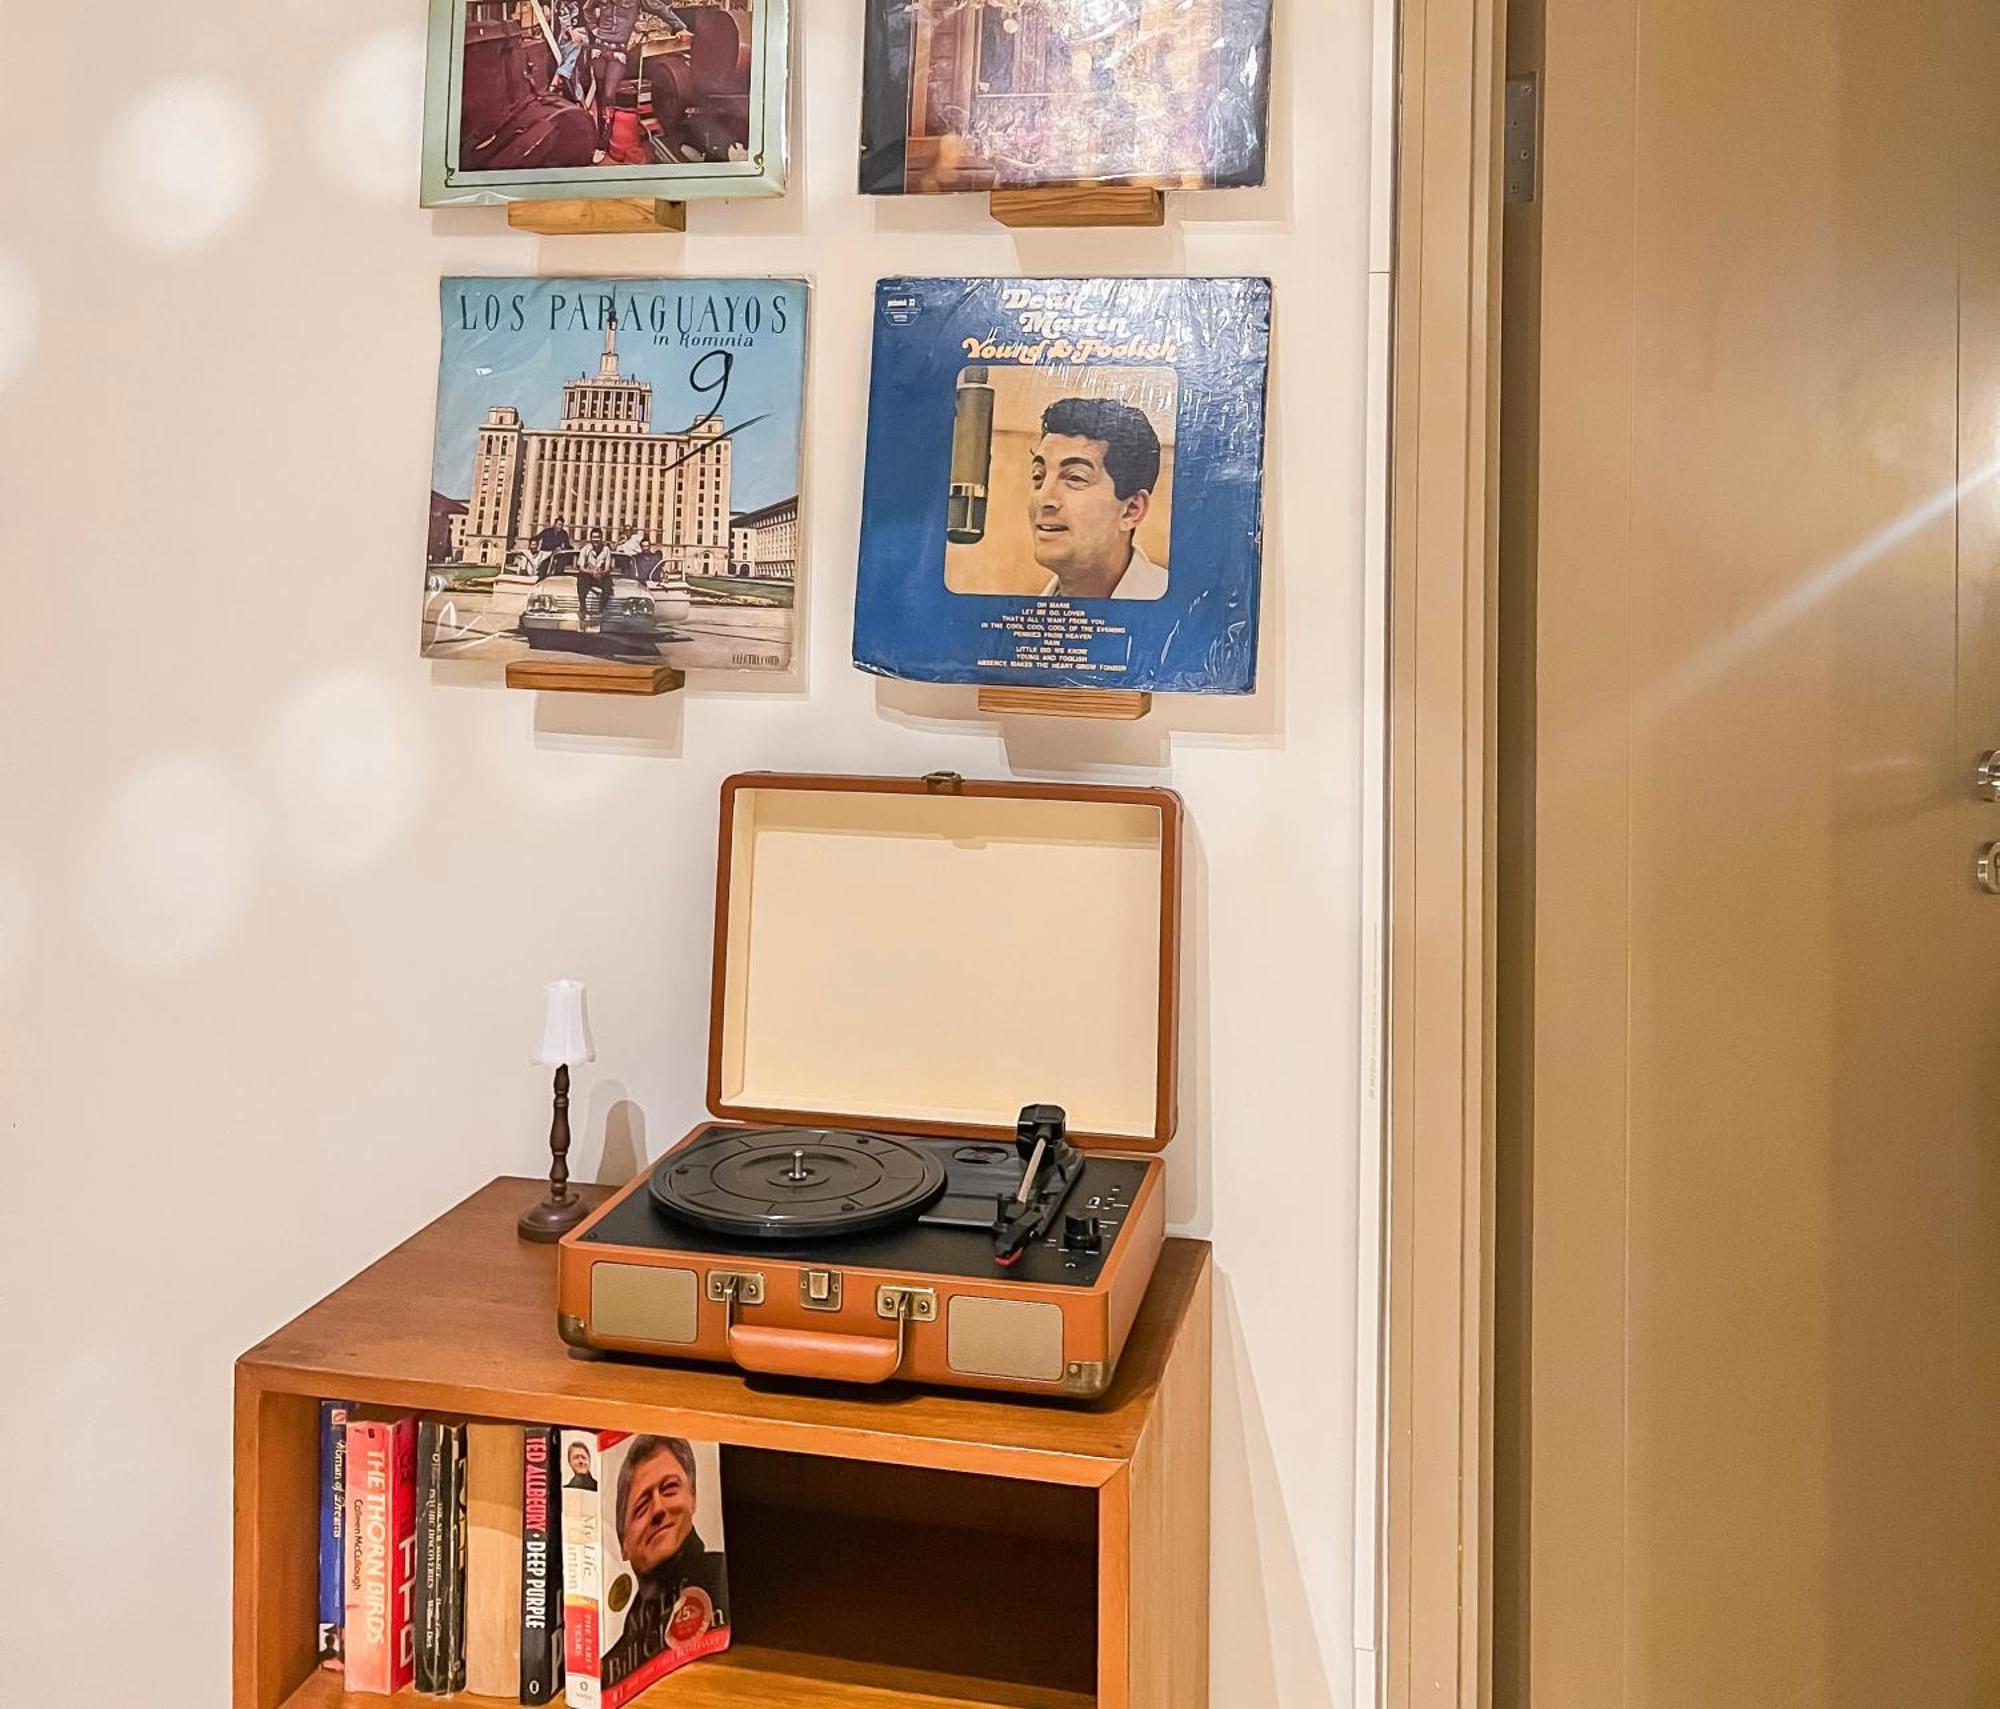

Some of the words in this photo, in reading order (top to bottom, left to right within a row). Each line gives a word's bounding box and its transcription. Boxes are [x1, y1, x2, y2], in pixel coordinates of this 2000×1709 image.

[460, 294, 525, 332] LOS
[550, 294, 787, 334] PARAGUAYOS
[1001, 287, 1088, 316] Dean
[652, 333, 670, 346] in
[1018, 311, 1131, 339] Martin
[961, 337, 1049, 364] Young
[1047, 339, 1073, 358] &
[1070, 335, 1178, 364] Foolish
[1065, 632, 1093, 640] HEAVEN
[526, 1436, 547, 1463] TED
[332, 1481, 344, 1492] of
[367, 1450, 386, 1490] THE
[526, 1463, 547, 1533] ALLBEURY
[354, 1499, 363, 1535] Colleen
[367, 1493, 387, 1577] THORN
[352, 1535, 363, 1591] McCullough
[526, 1541, 547, 1577] DEEP
[366, 1581, 386, 1645] BIRDS
[525, 1578, 547, 1629] PURPLE
